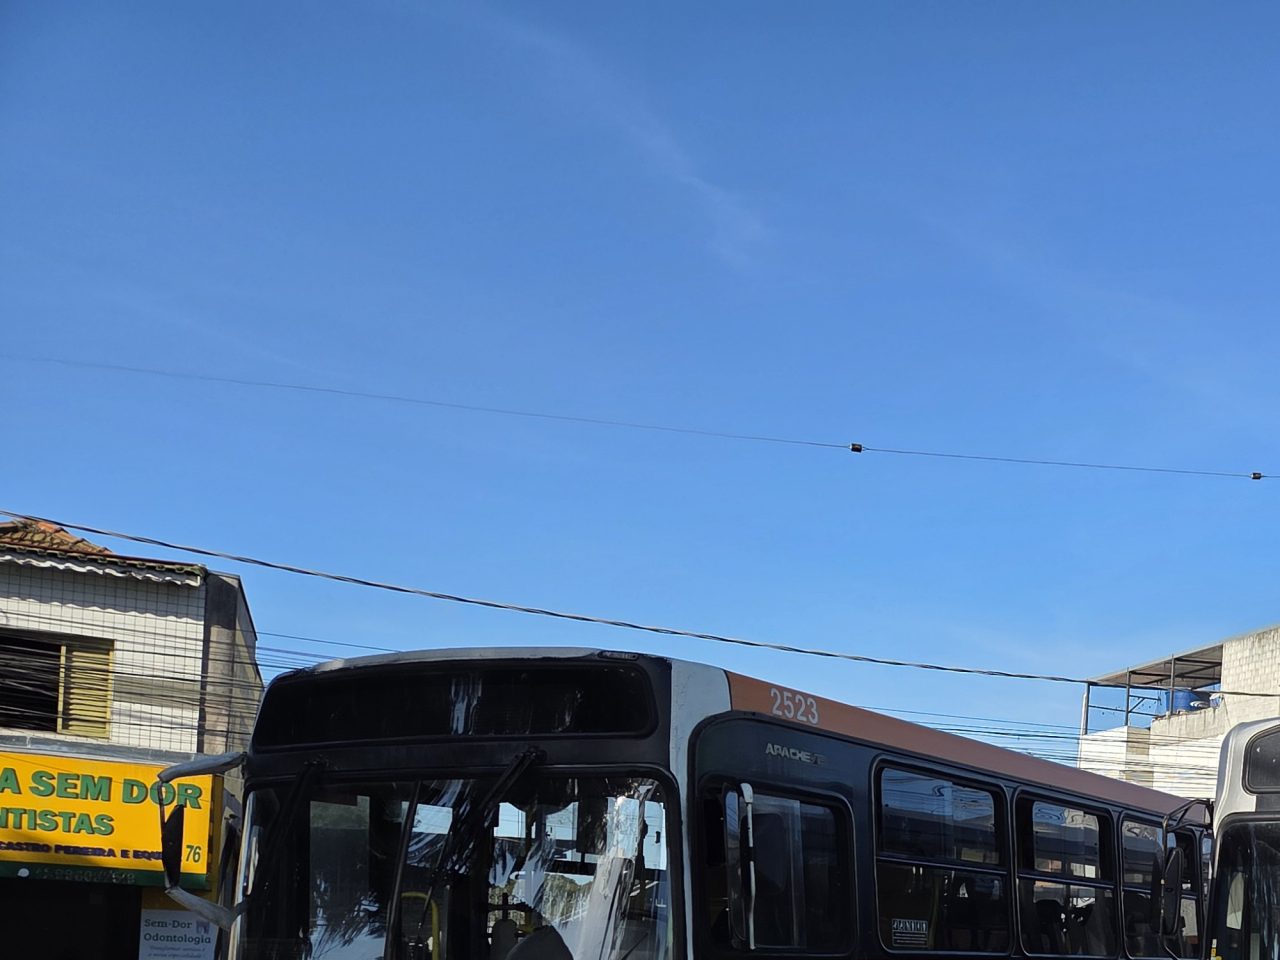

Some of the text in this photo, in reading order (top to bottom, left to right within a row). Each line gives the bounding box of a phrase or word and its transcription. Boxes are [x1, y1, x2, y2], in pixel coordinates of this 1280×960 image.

[770, 687, 819, 724] 2523
[29, 770, 113, 802] SEM
[122, 778, 202, 809] DOR
[54, 844, 117, 859] PEREIRA
[186, 845, 201, 863] 76
[144, 932, 211, 945] Odontologia
